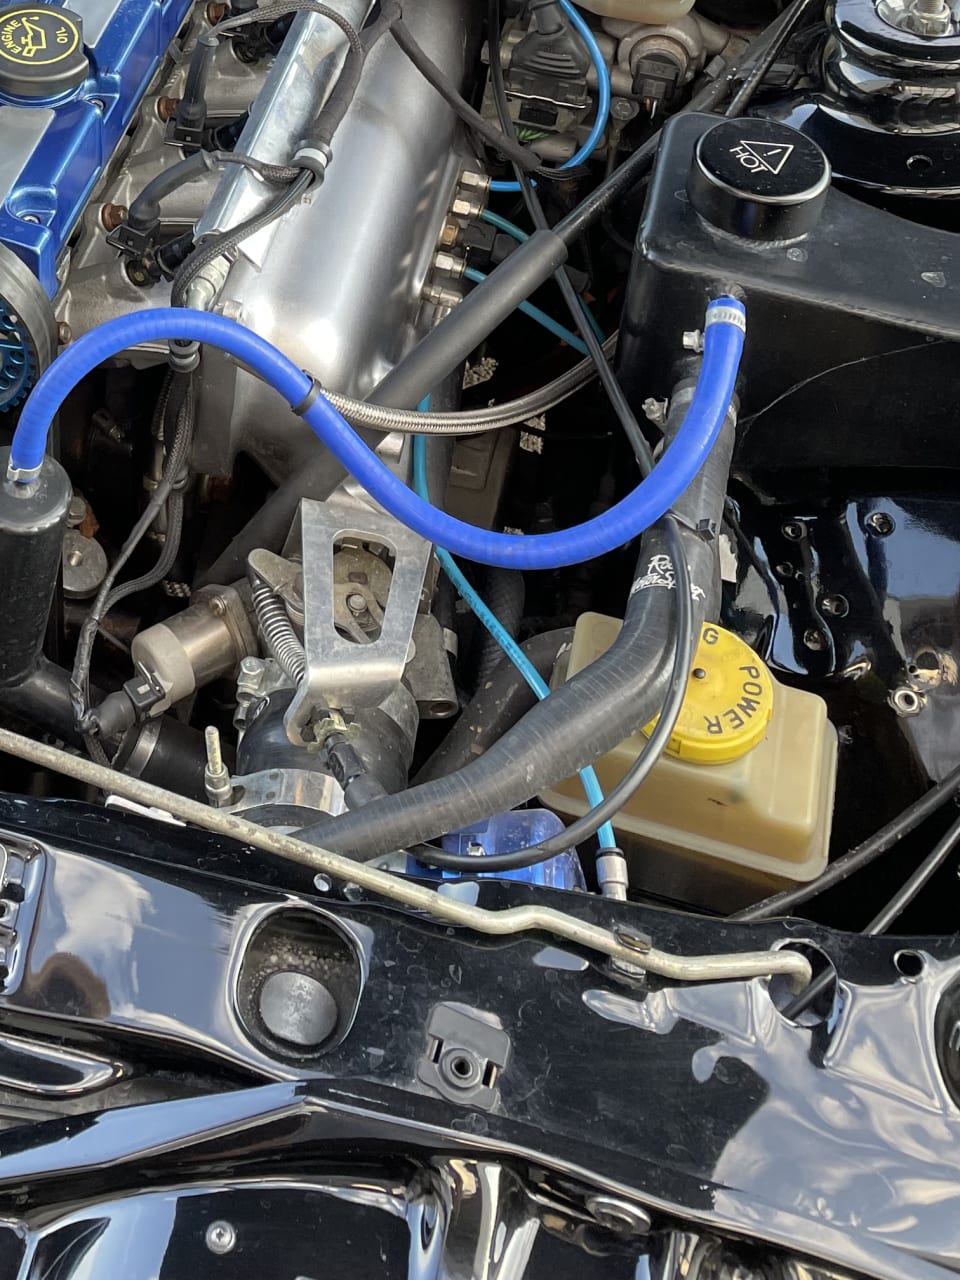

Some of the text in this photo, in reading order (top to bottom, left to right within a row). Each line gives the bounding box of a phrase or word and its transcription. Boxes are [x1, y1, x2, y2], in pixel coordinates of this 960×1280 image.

[2, 20, 21, 54] ENGINE
[56, 27, 68, 43] OIL
[729, 146, 768, 172] HOT
[704, 665, 763, 735] POWER
